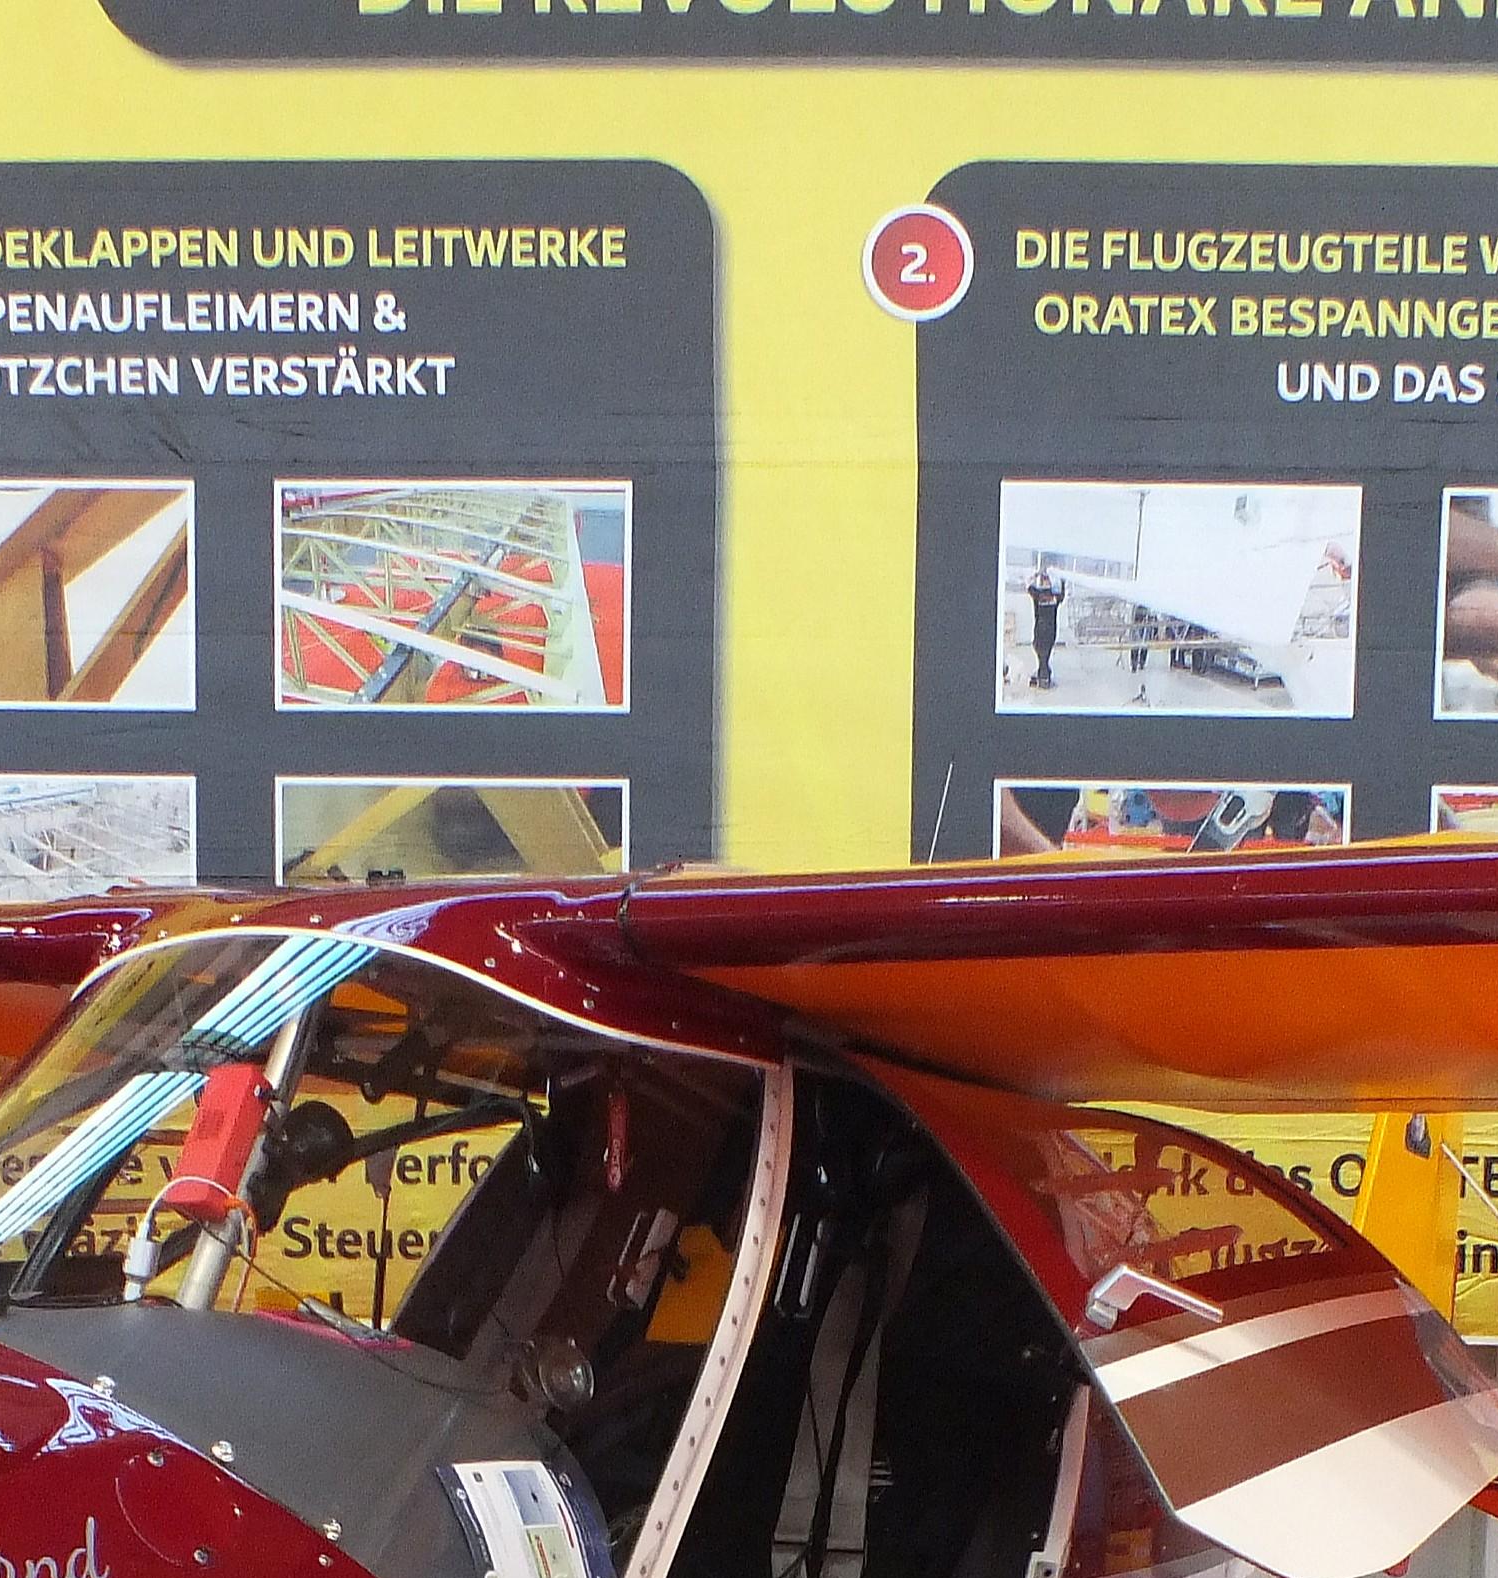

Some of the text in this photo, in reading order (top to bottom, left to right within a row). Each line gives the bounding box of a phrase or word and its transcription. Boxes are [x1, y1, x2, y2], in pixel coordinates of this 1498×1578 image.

[253, 226, 356, 270] UND
[369, 226, 628, 270] LEITWERKE
[898, 243, 938, 284] 2.
[1016, 229, 1091, 271] DIE
[1103, 231, 1469, 276] FLUGZEUGTEILE
[373, 291, 409, 334] &
[1034, 293, 1218, 338] ORATEX
[192, 345, 458, 399] VERSTÄRKT
[1277, 362, 1383, 404] UND
[1394, 363, 1488, 405] DAS
